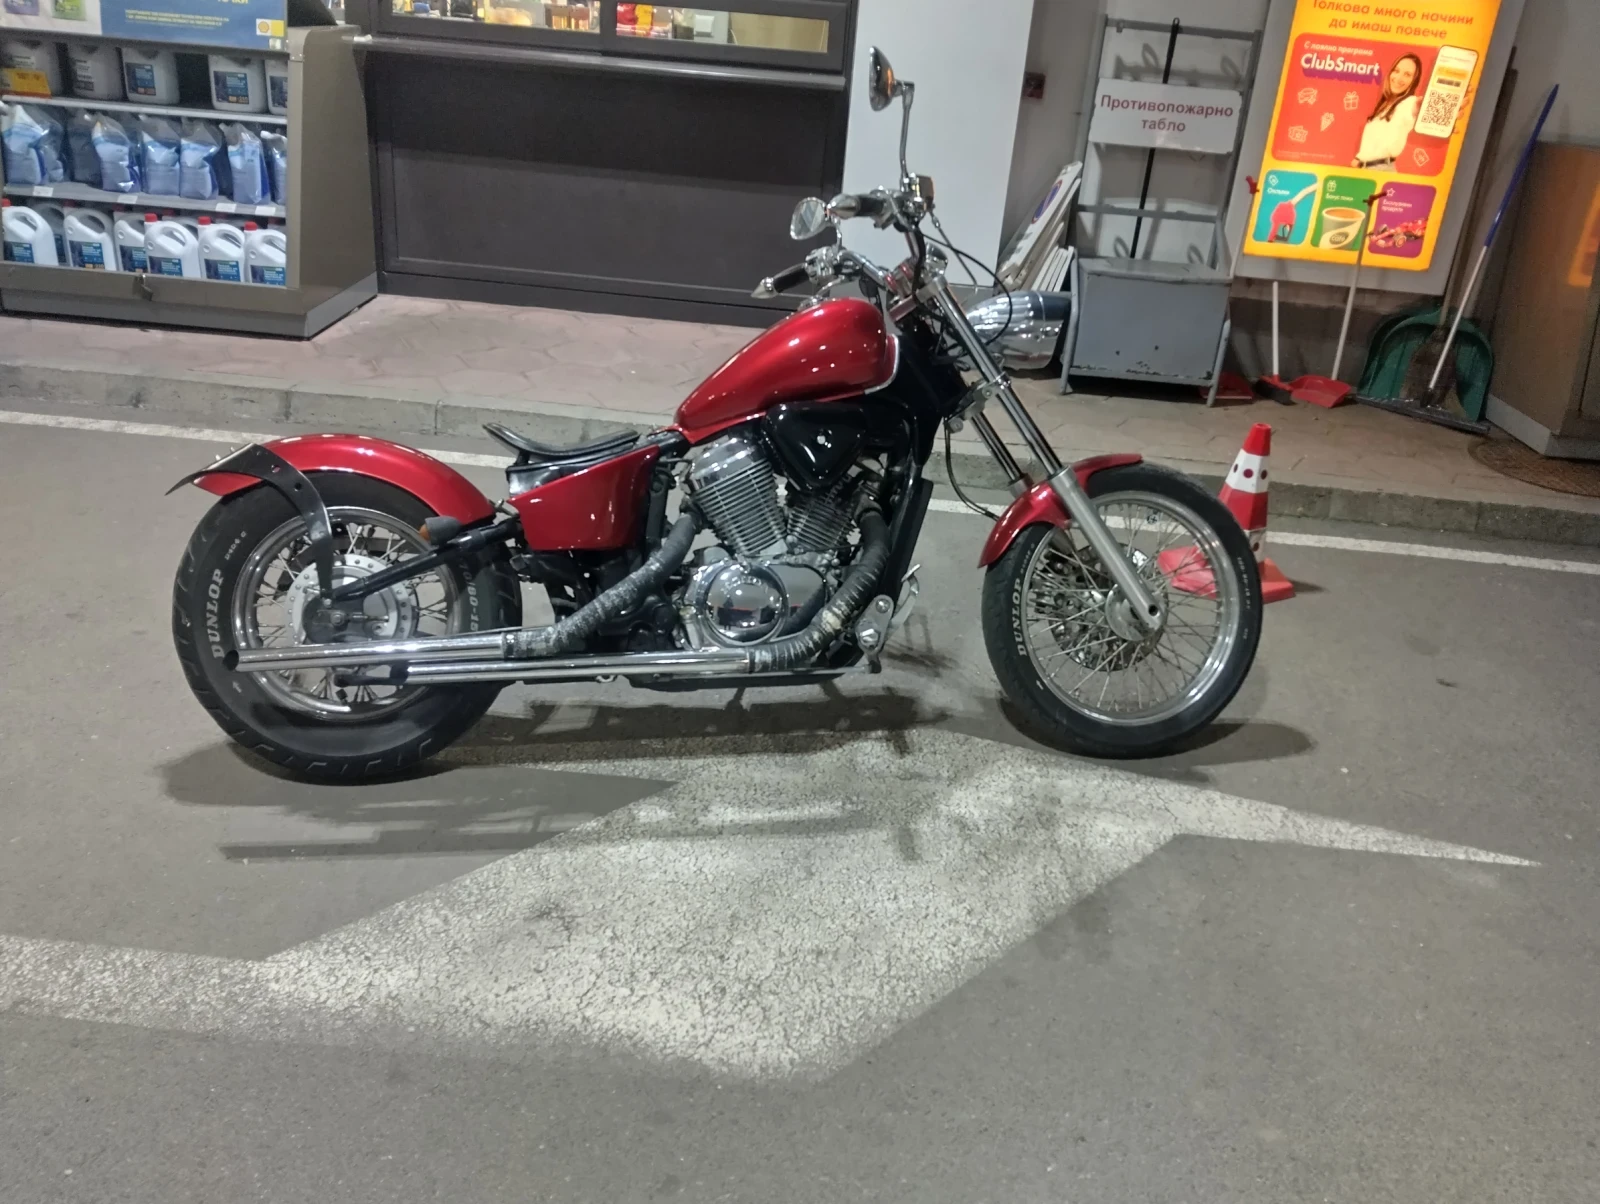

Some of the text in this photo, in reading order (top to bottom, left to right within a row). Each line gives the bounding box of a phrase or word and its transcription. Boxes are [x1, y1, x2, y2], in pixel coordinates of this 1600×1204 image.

[1374, 6, 1417, 20] много
[1421, 11, 1474, 25] начини
[1328, 18, 1447, 39] да имаш повече
[1301, 52, 1380, 76] ClubSmart
[1100, 94, 1234, 119] Противопожарно
[1141, 117, 1186, 132] табло
[205, 568, 226, 658] DUNLOP
[1012, 578, 1028, 656] DUNLOP
